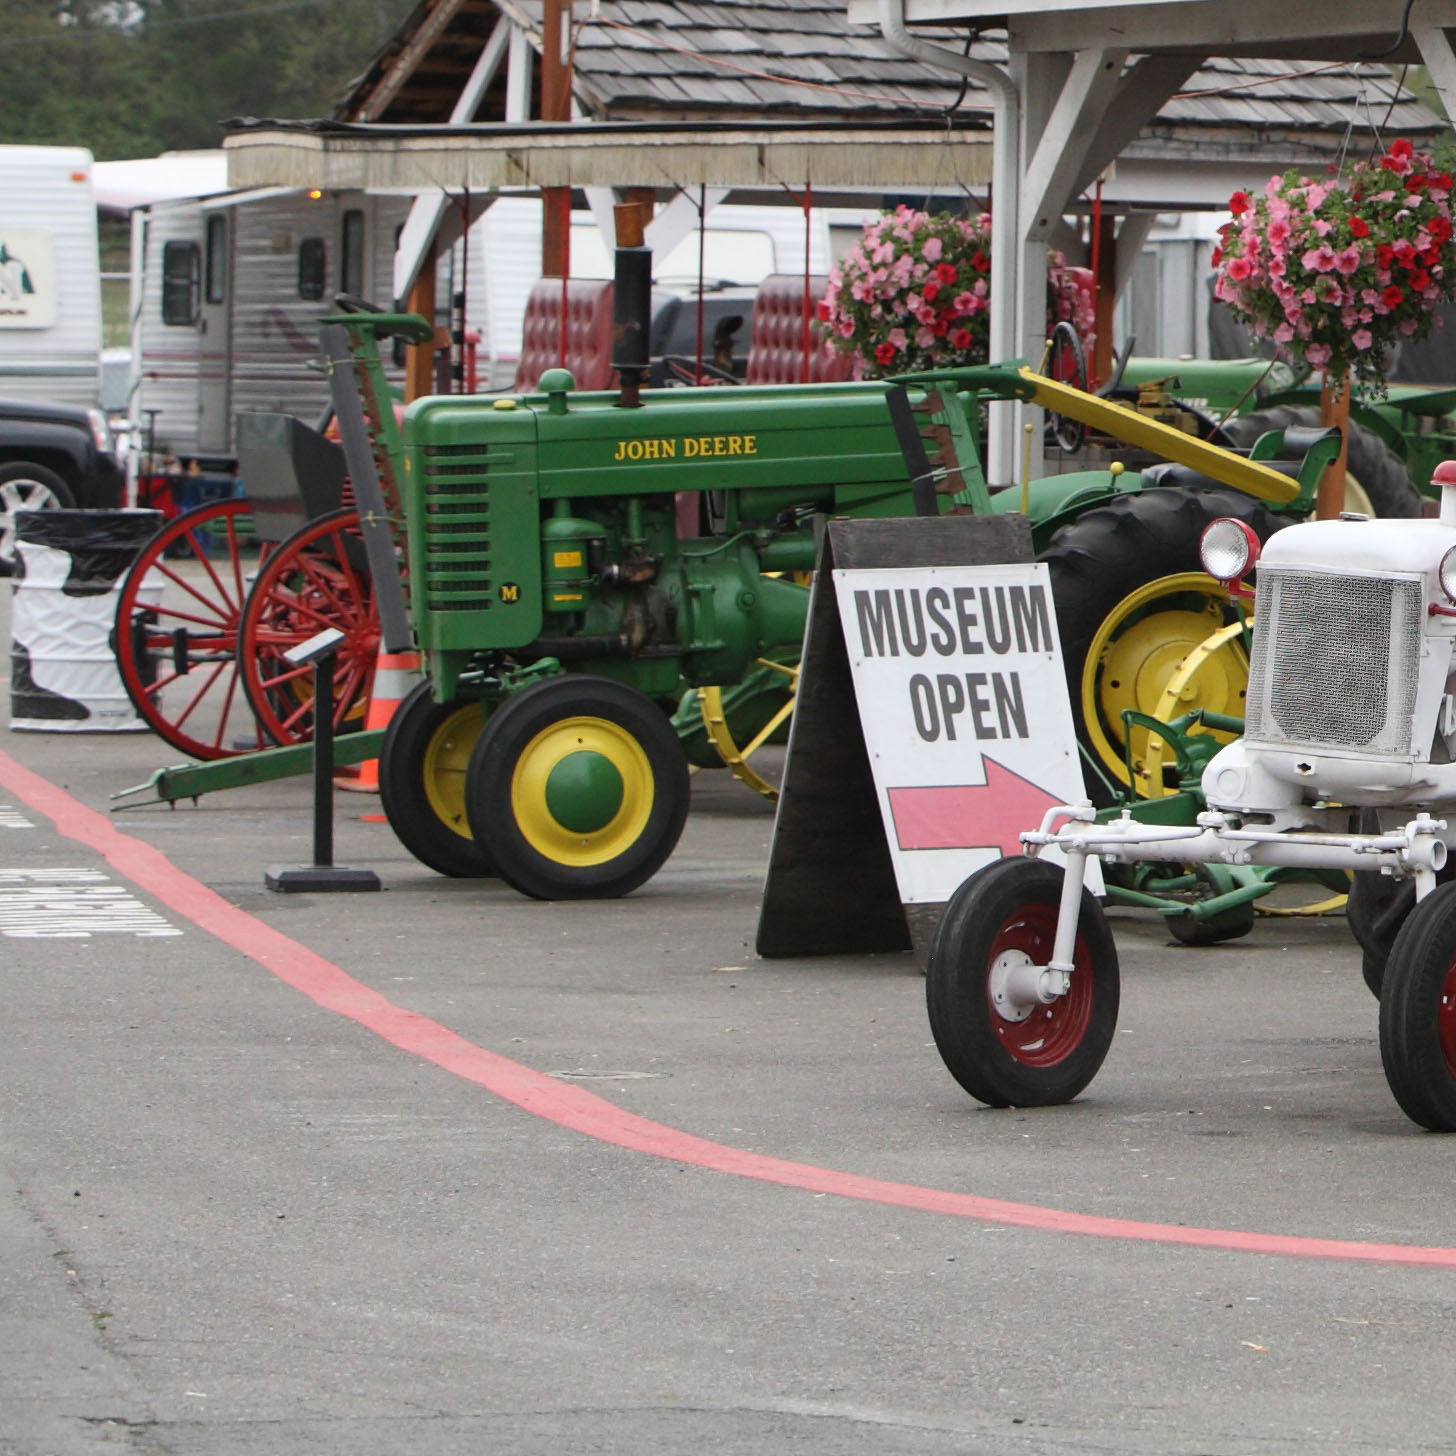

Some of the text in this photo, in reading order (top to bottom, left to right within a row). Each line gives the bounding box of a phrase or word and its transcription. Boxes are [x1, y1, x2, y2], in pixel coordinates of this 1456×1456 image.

[614, 435, 757, 461] JOHN DEERE
[501, 585, 518, 600] M
[853, 585, 1054, 658] MUSEUM
[909, 671, 1029, 742] OPEN
